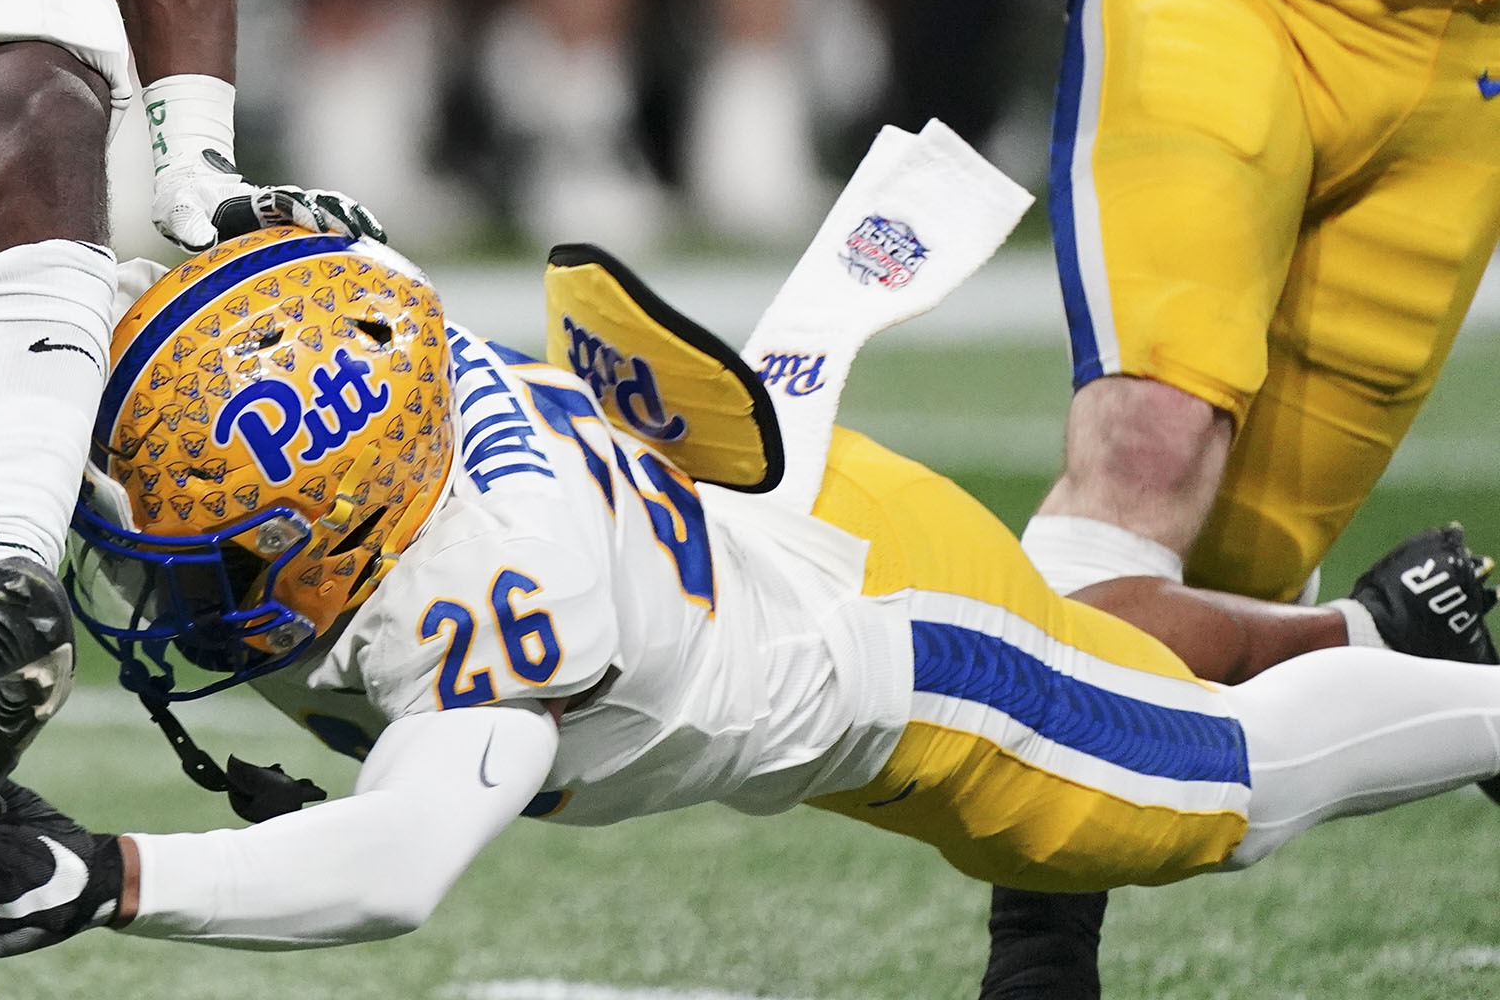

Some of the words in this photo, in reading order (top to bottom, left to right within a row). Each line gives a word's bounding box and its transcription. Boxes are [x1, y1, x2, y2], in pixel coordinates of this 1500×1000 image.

[213, 347, 391, 485] Pitt
[445, 326, 557, 495] TALLA
[561, 313, 687, 443] Pitt
[755, 352, 826, 396] Pitt
[416, 565, 564, 712] 26
